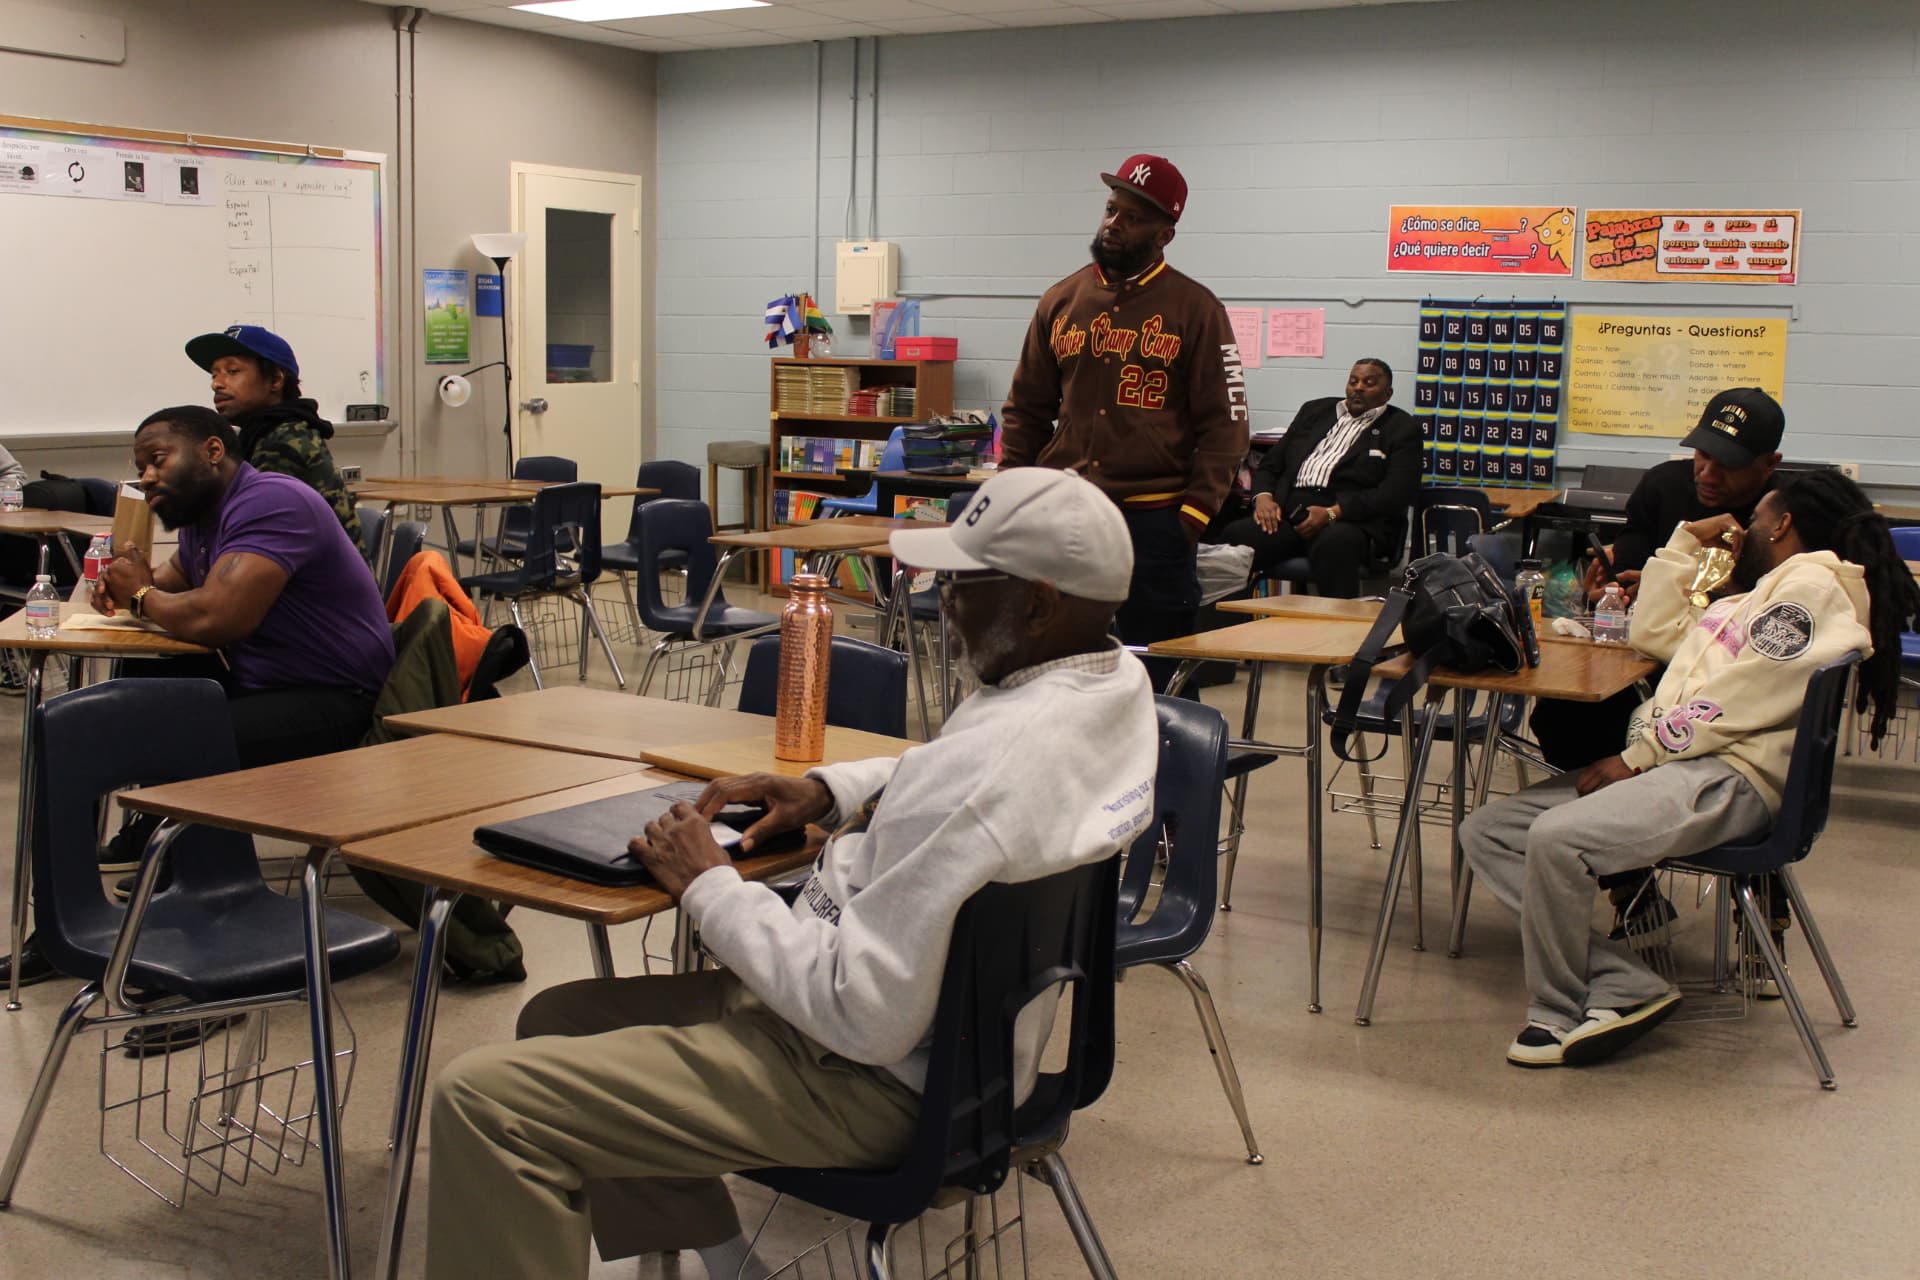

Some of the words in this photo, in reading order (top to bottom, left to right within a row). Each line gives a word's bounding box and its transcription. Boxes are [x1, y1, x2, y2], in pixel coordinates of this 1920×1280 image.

[1129, 163, 1151, 186] NY
[1401, 216, 1438, 233] ¿Cómo
[1440, 220, 1453, 231] se
[1456, 217, 1480, 231] dice
[1586, 216, 1663, 242] Palabras
[1726, 219, 1750, 229] pero
[1393, 242, 1421, 258] ¿Qué
[1423, 244, 1458, 259] quiere
[1461, 242, 1490, 258] decir
[1613, 235, 1636, 249] de
[1663, 239, 1699, 249] porque
[1750, 239, 1788, 249] cuando
[1590, 245, 1657, 268] enlace
[1664, 256, 1709, 265] entonces
[1747, 256, 1787, 266] aunque
[1424, 323, 1436, 334] 01
[1448, 323, 1459, 334] 02
[1471, 323, 1483, 335] 03
[1495, 324, 1507, 336] 04
[1519, 324, 1531, 336] 05
[1544, 325, 1556, 337] 06
[1598, 322, 1671, 337] ¿Preguntas
[1688, 324, 1766, 338] Questions?
[1091, 311, 1138, 362] Champ
[1141, 314, 1182, 367] Camp
[1423, 356, 1434, 368] 07
[1445, 358, 1457, 369] 08
[1469, 358, 1481, 370] 09
[1494, 359, 1506, 371] 10
[1518, 359, 1529, 372] 11
[1543, 360, 1554, 372] 12
[1117, 364, 1168, 409] 22
[1220, 343, 1248, 422] MMCC
[1420, 389, 1432, 401] 13
[1444, 390, 1455, 403] 14
[1467, 391, 1479, 404] 15
[1491, 392, 1503, 405] 16
[1516, 394, 1527, 406] 17
[1540, 394, 1552, 407] 18
[1440, 423, 1452, 436] 20
[1464, 425, 1475, 437] 21
[1487, 426, 1499, 439] 22
[1511, 427, 1522, 440] 23
[1535, 429, 1547, 442] 24
[1439, 458, 1451, 470] 26
[1463, 459, 1475, 472] 27
[1487, 461, 1499, 473] 28
[1510, 462, 1522, 474] 29
[1534, 464, 1546, 476] 30
